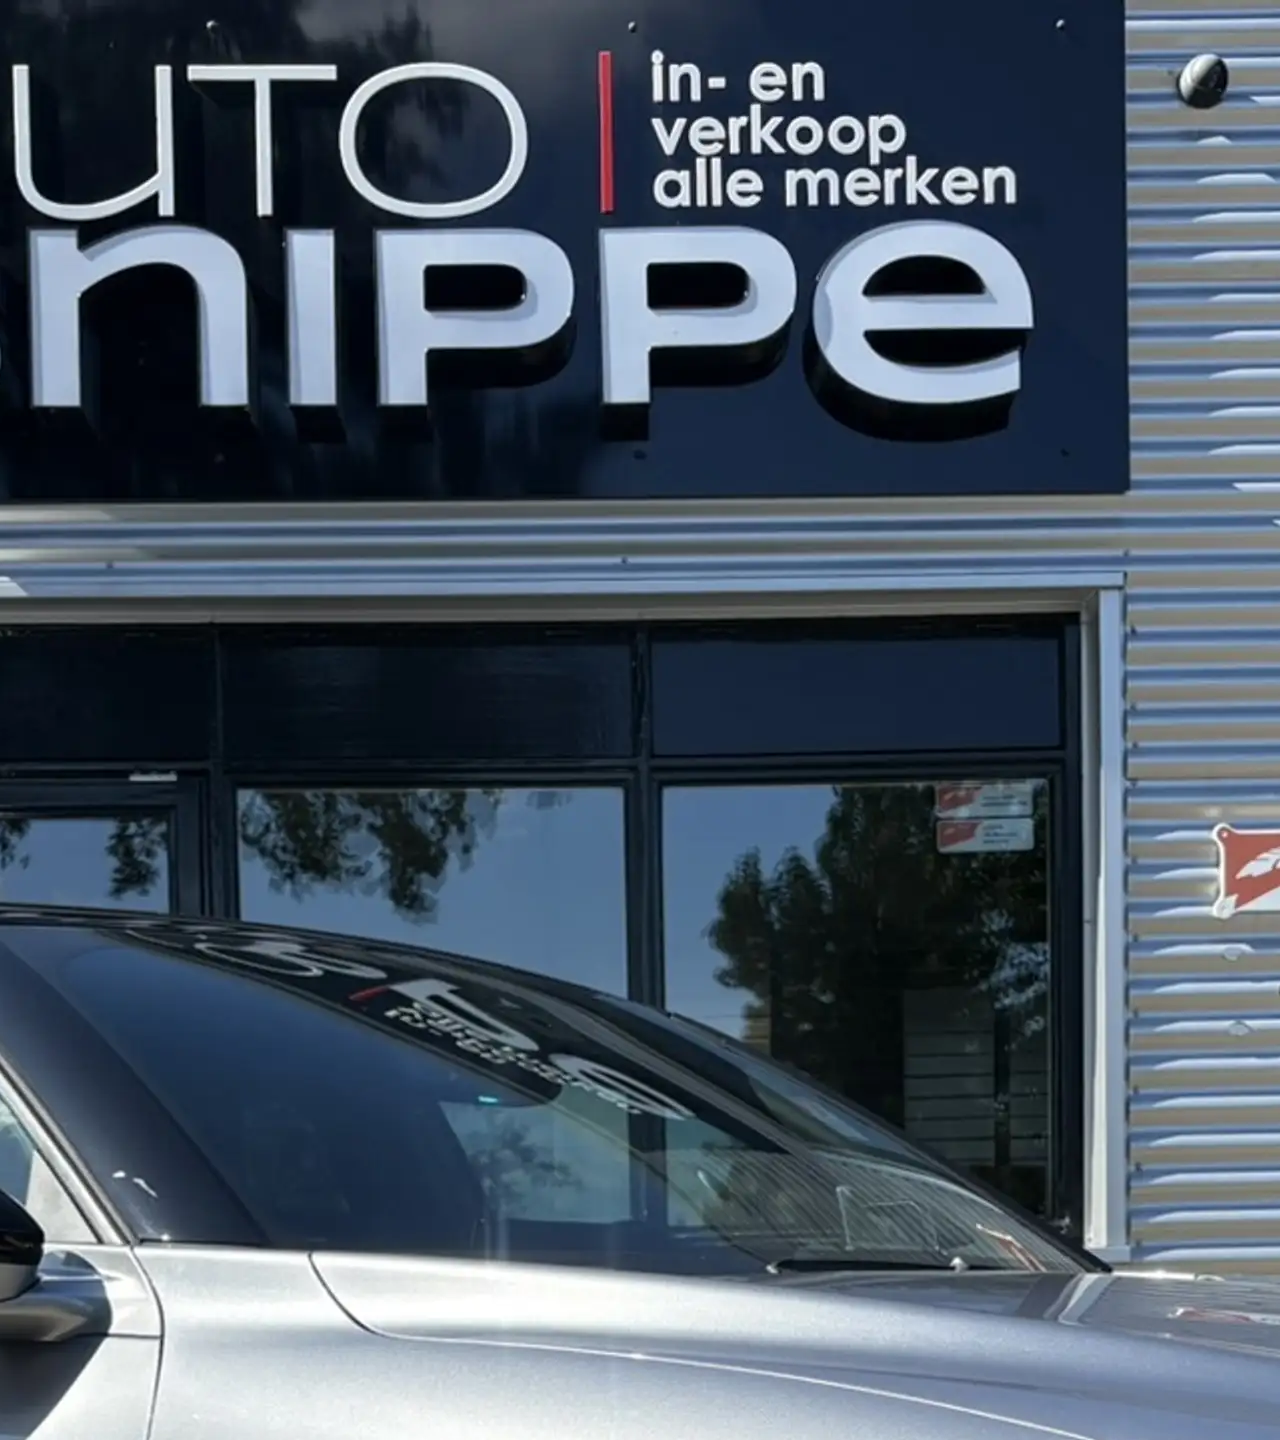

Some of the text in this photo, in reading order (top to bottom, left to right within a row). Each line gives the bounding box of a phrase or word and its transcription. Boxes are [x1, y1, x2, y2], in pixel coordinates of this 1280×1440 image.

[651, 50, 825, 102] in- en
[651, 104, 906, 165] verkoop
[653, 156, 1017, 207] alle merken
